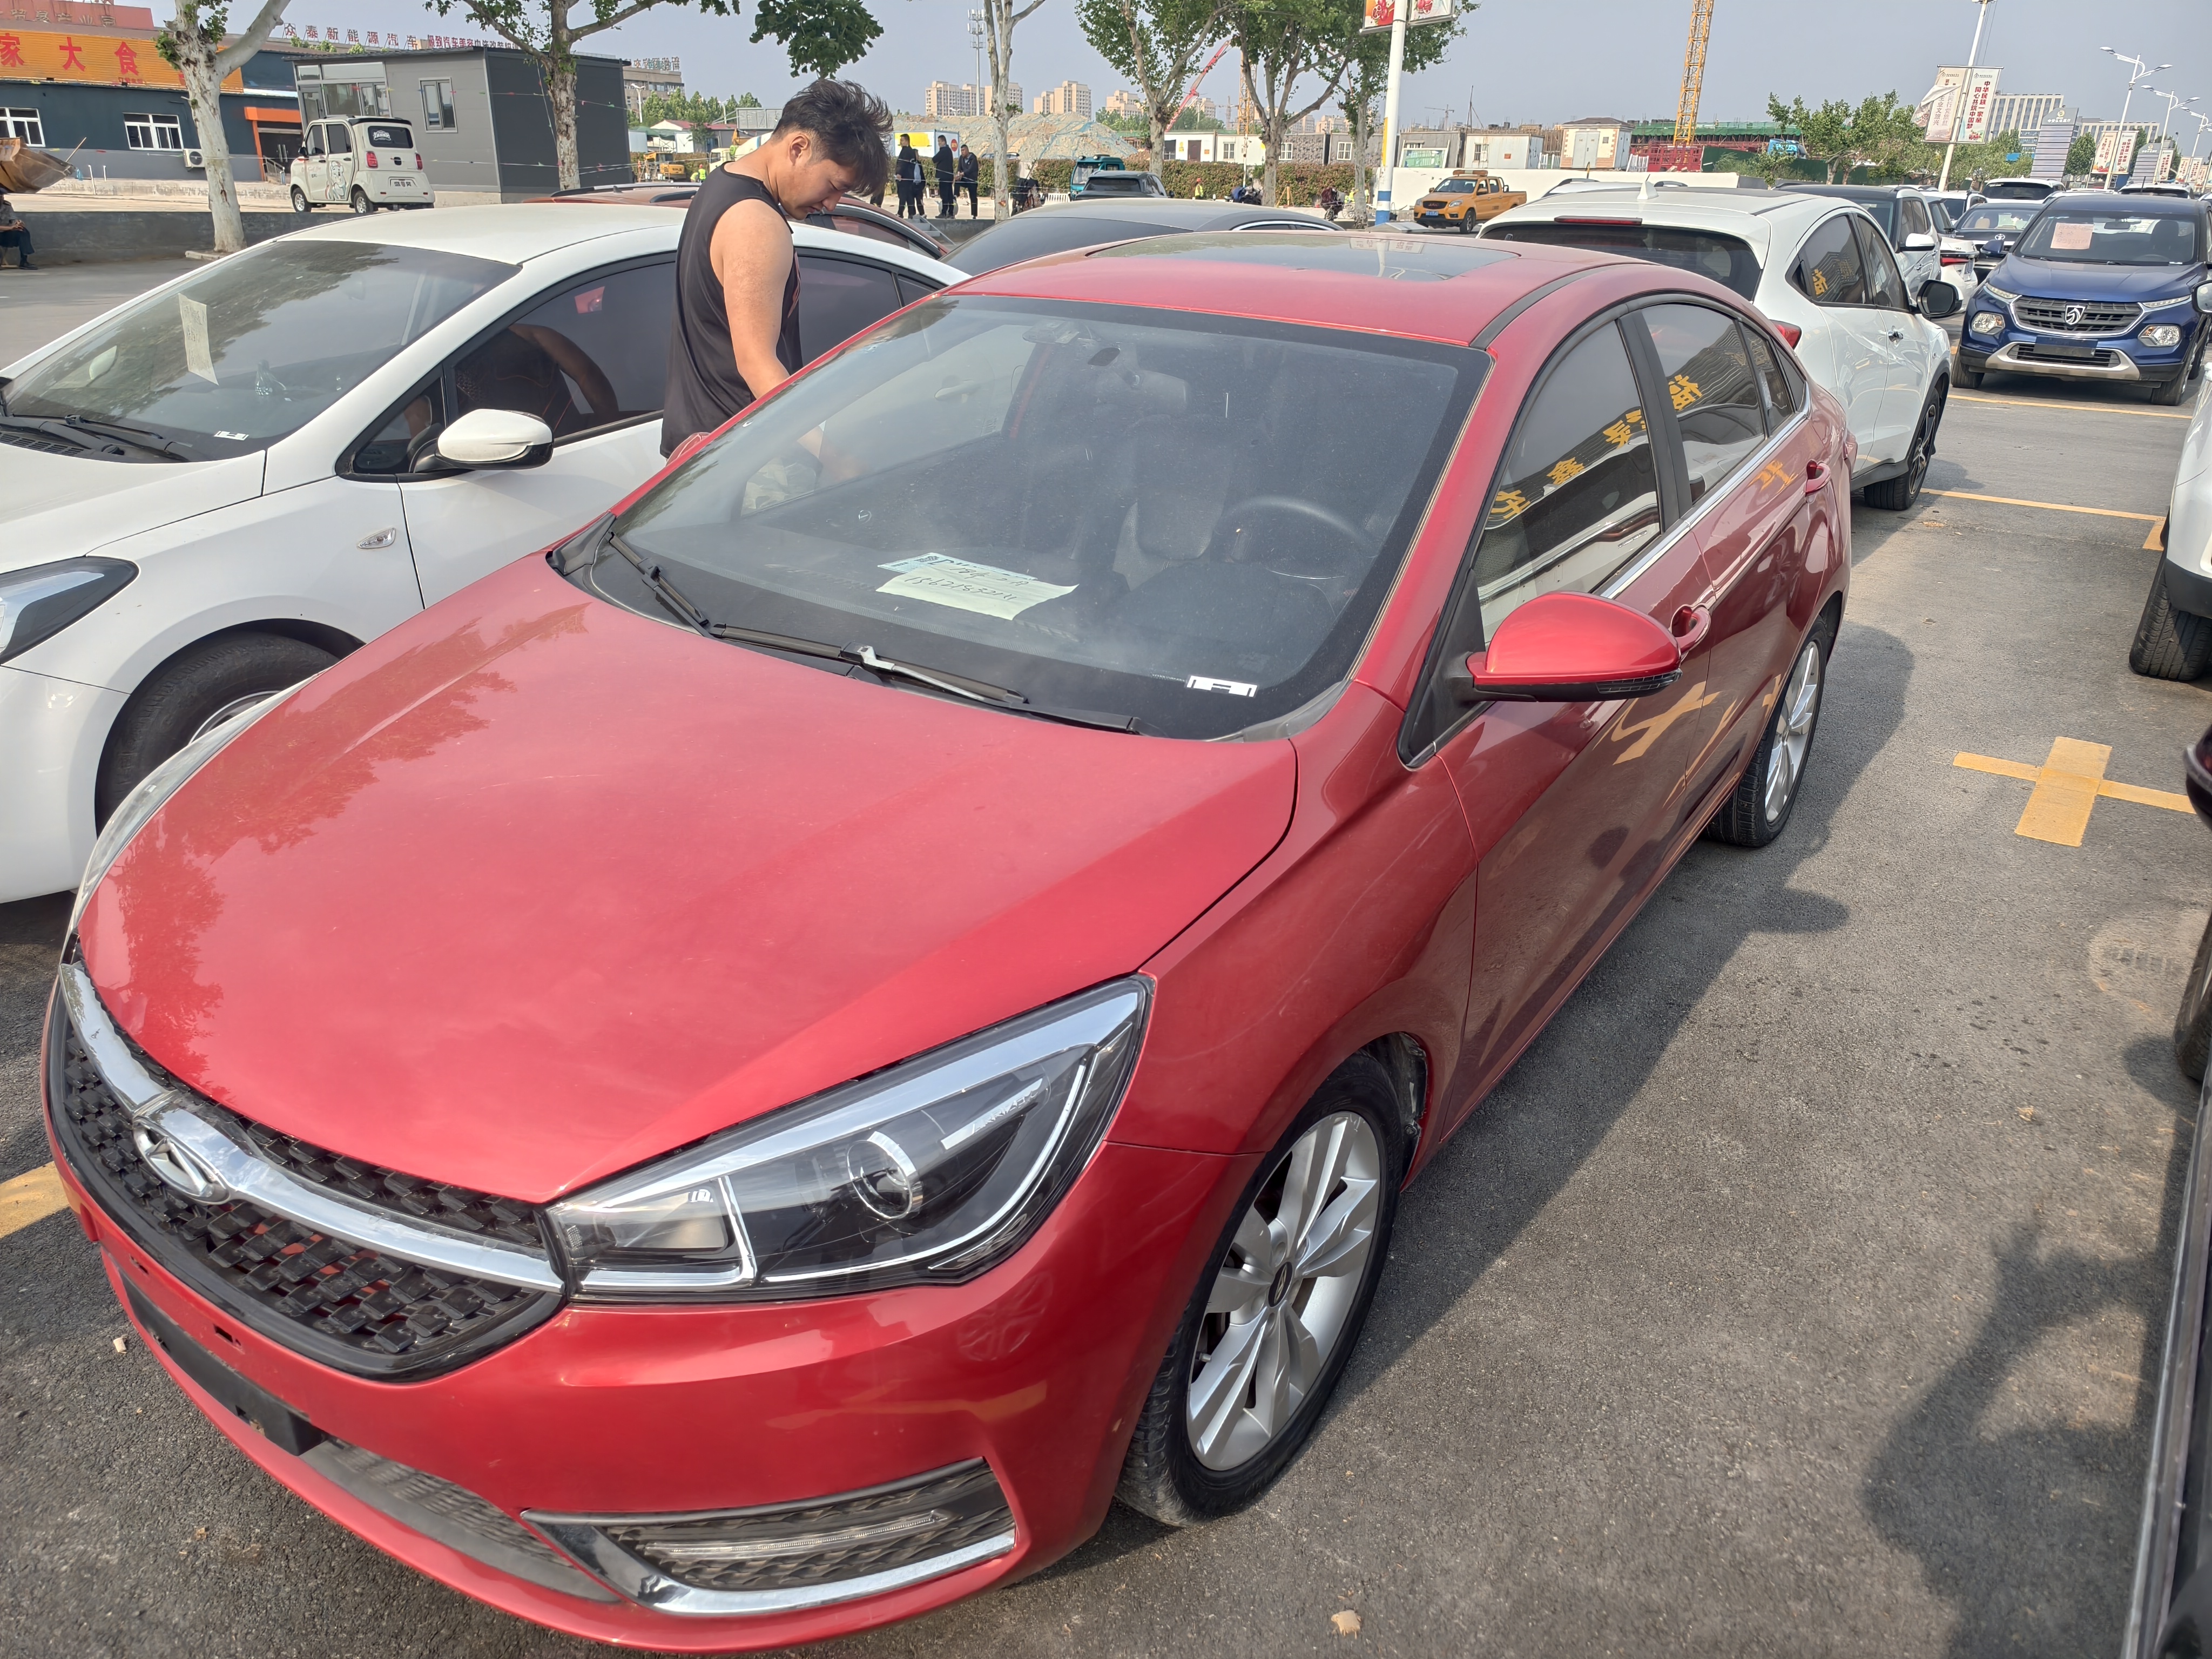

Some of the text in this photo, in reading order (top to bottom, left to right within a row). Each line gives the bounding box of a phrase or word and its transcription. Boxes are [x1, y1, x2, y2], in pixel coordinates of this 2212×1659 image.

[285, 23, 418, 48] 众泰新能源汽车
[1966, 87, 1982, 129] 同心共筑中国梦
[1975, 80, 1991, 123] 中华民族一家亲
